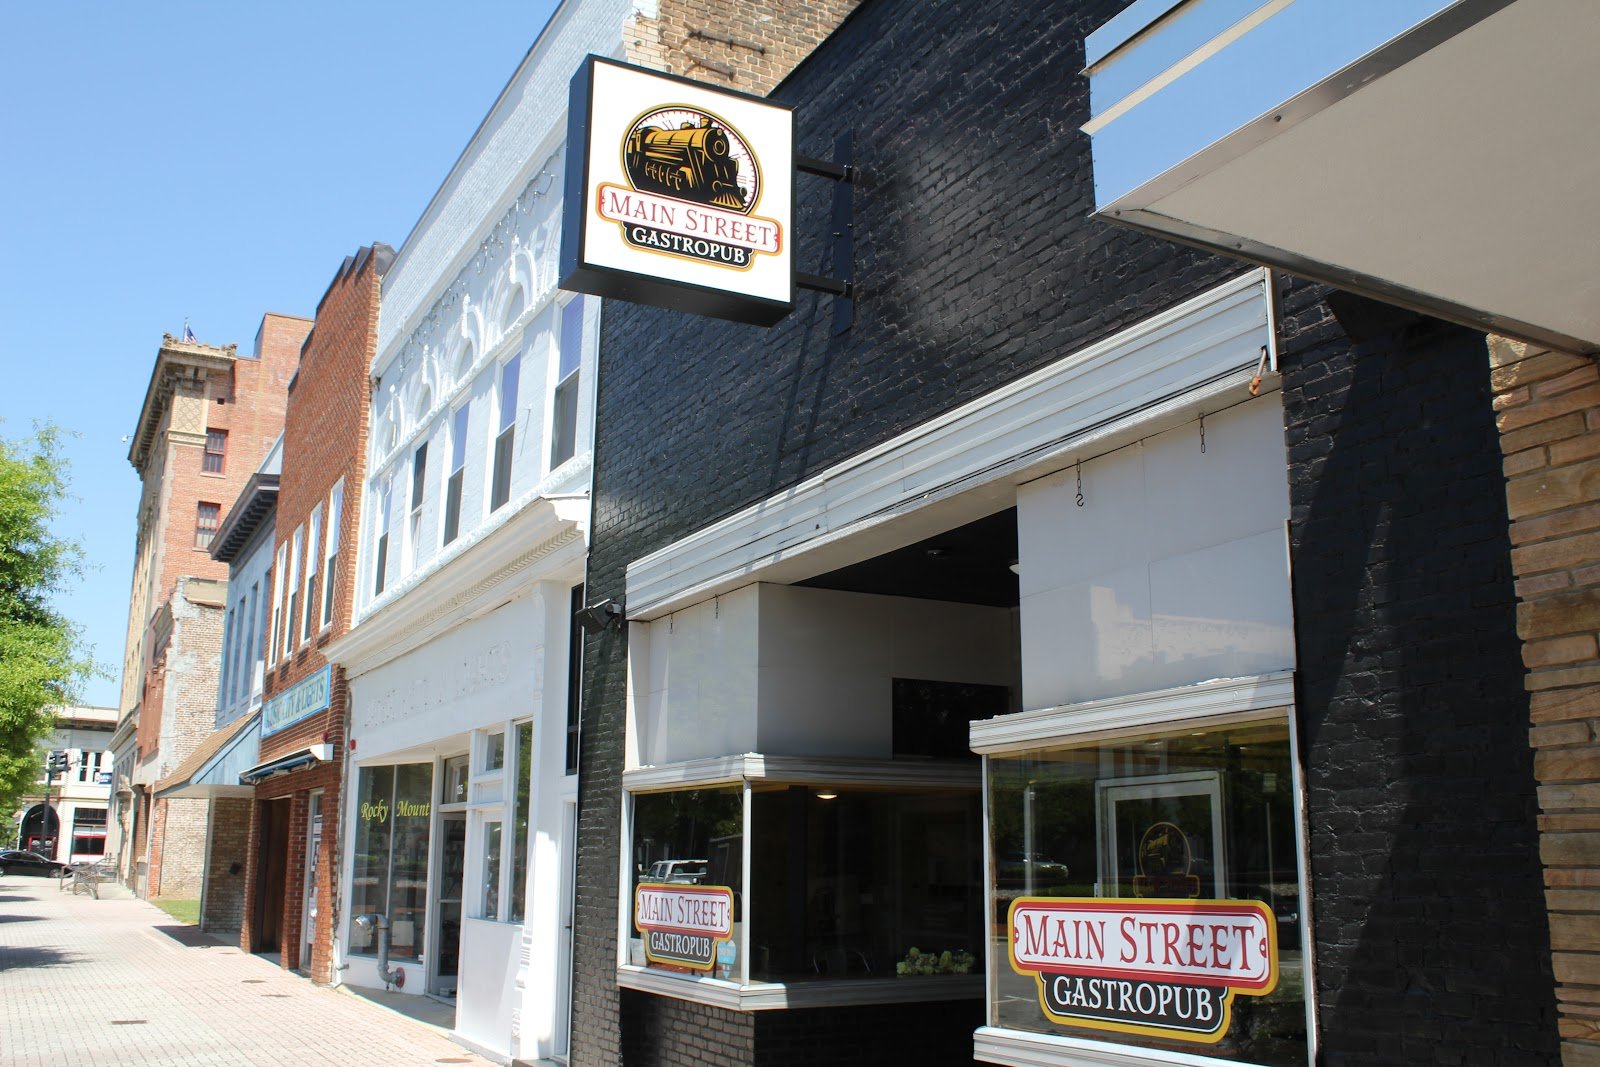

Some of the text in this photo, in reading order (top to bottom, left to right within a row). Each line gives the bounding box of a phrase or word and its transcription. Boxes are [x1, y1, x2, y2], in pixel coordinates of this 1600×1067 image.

[609, 191, 772, 246] MAIN STREET
[632, 227, 745, 264] GASTROPUB
[361, 799, 430, 823] Rocky Mount
[641, 894, 726, 927] MAIN STREET
[651, 932, 710, 957] GASTROPUB
[1023, 914, 1255, 971] MAIN STREET
[1053, 975, 1213, 1022] GASTROPUB
